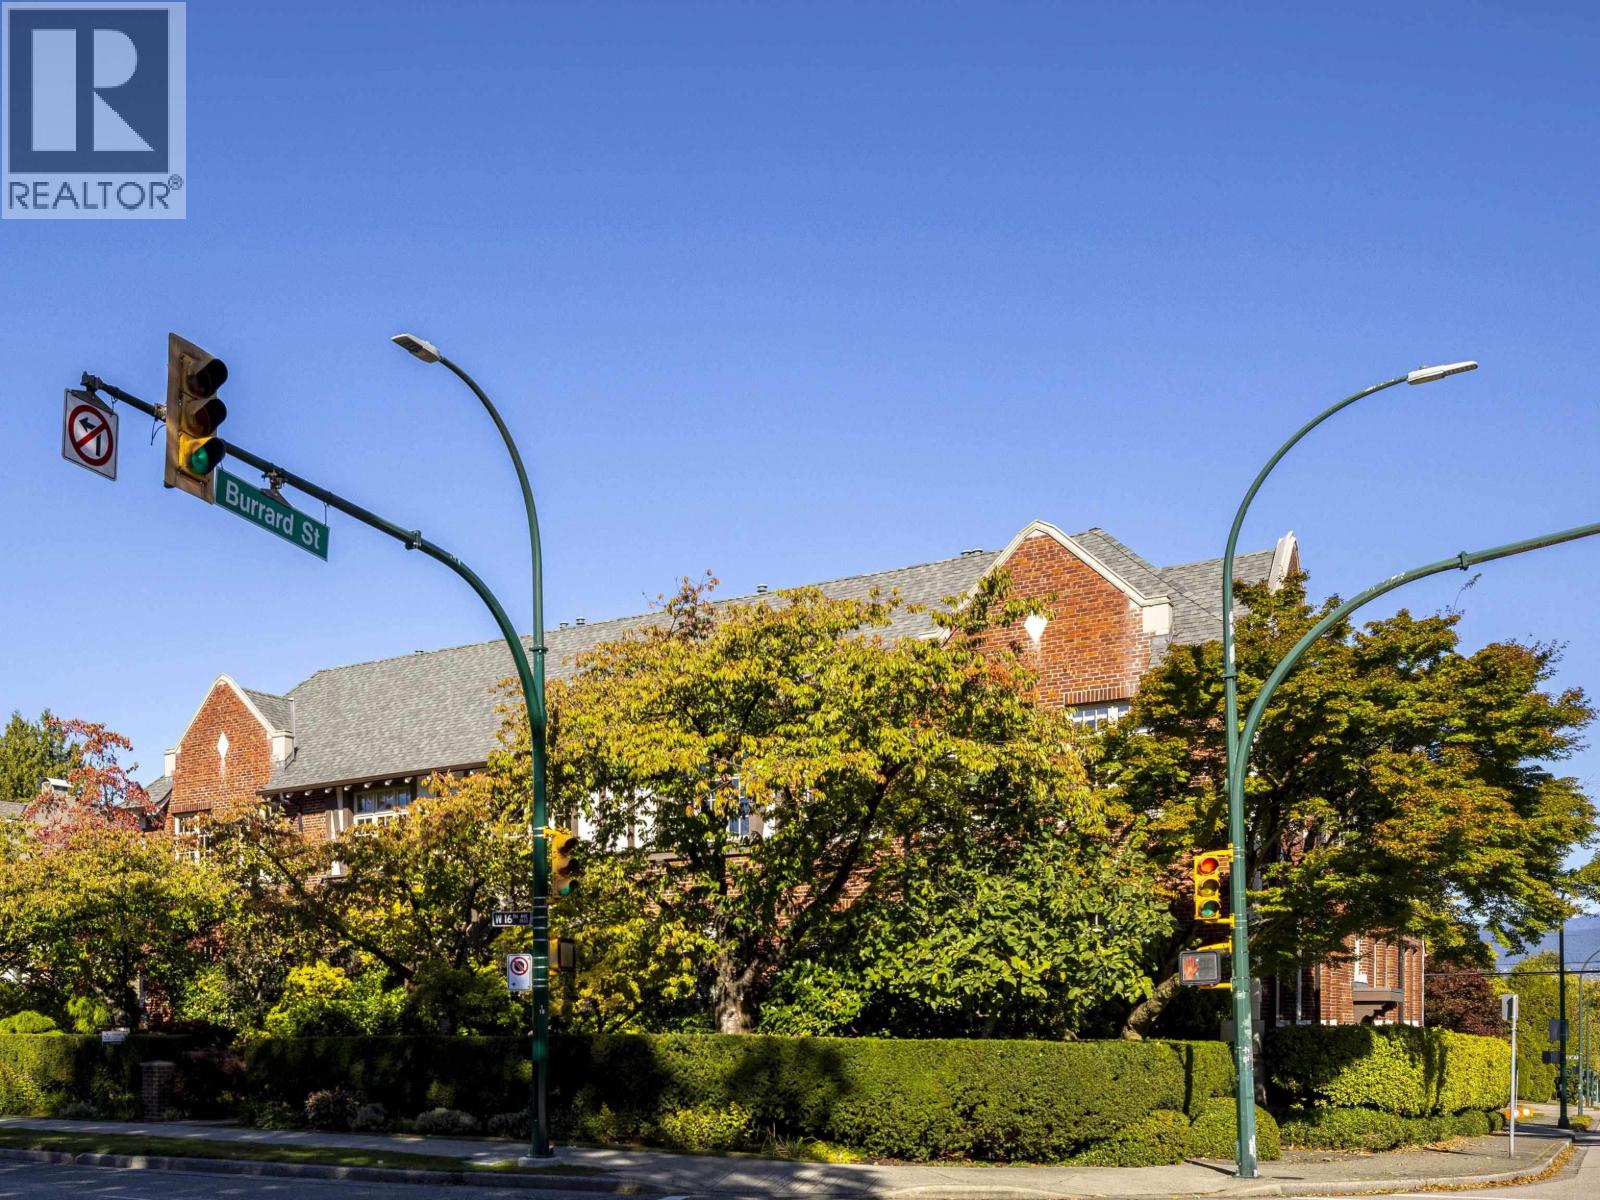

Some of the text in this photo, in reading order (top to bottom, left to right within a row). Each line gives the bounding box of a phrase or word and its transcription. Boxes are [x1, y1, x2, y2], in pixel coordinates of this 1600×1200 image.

[225, 480, 321, 549] Burrard St
[495, 914, 503, 925] W
[504, 914, 513, 925] 16
